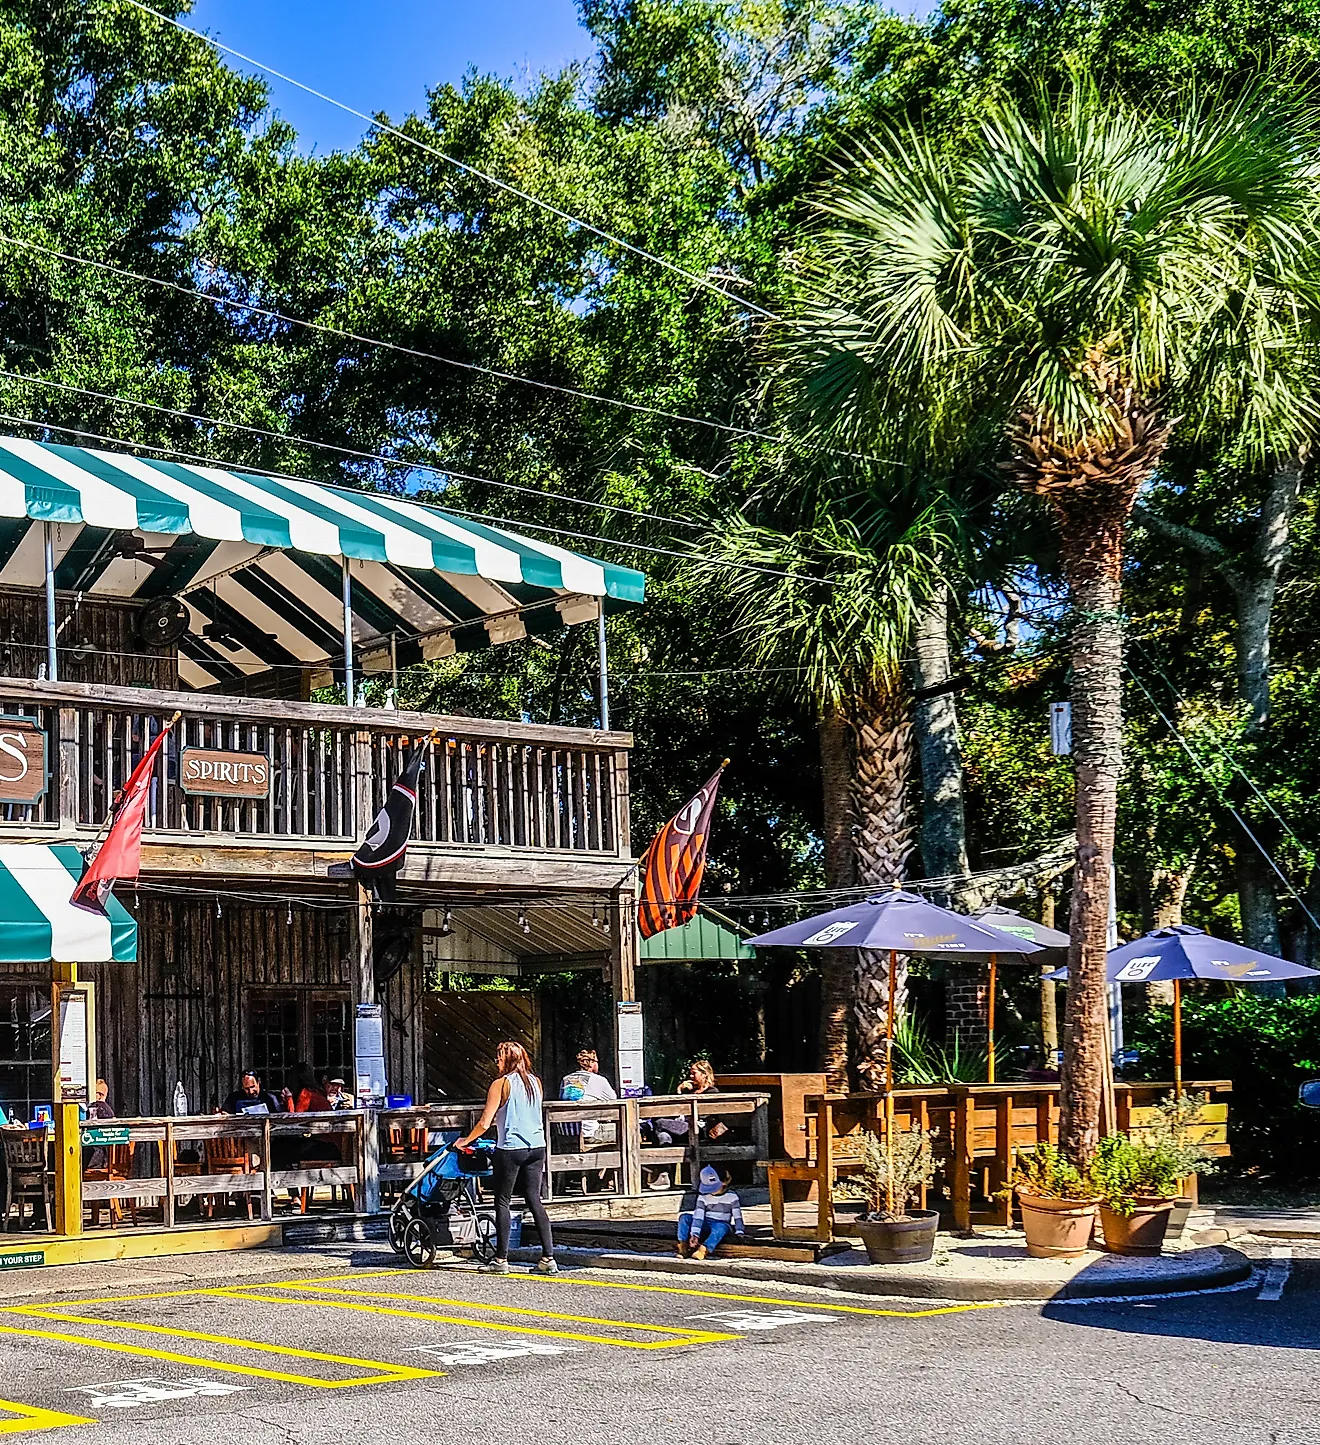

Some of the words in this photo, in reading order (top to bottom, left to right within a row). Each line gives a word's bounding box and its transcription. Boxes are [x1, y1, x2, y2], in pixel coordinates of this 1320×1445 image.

[186, 759, 266, 785] SPIRITS
[3, 1256, 23, 1265] YOUR
[24, 1254, 42, 1263] STEP
